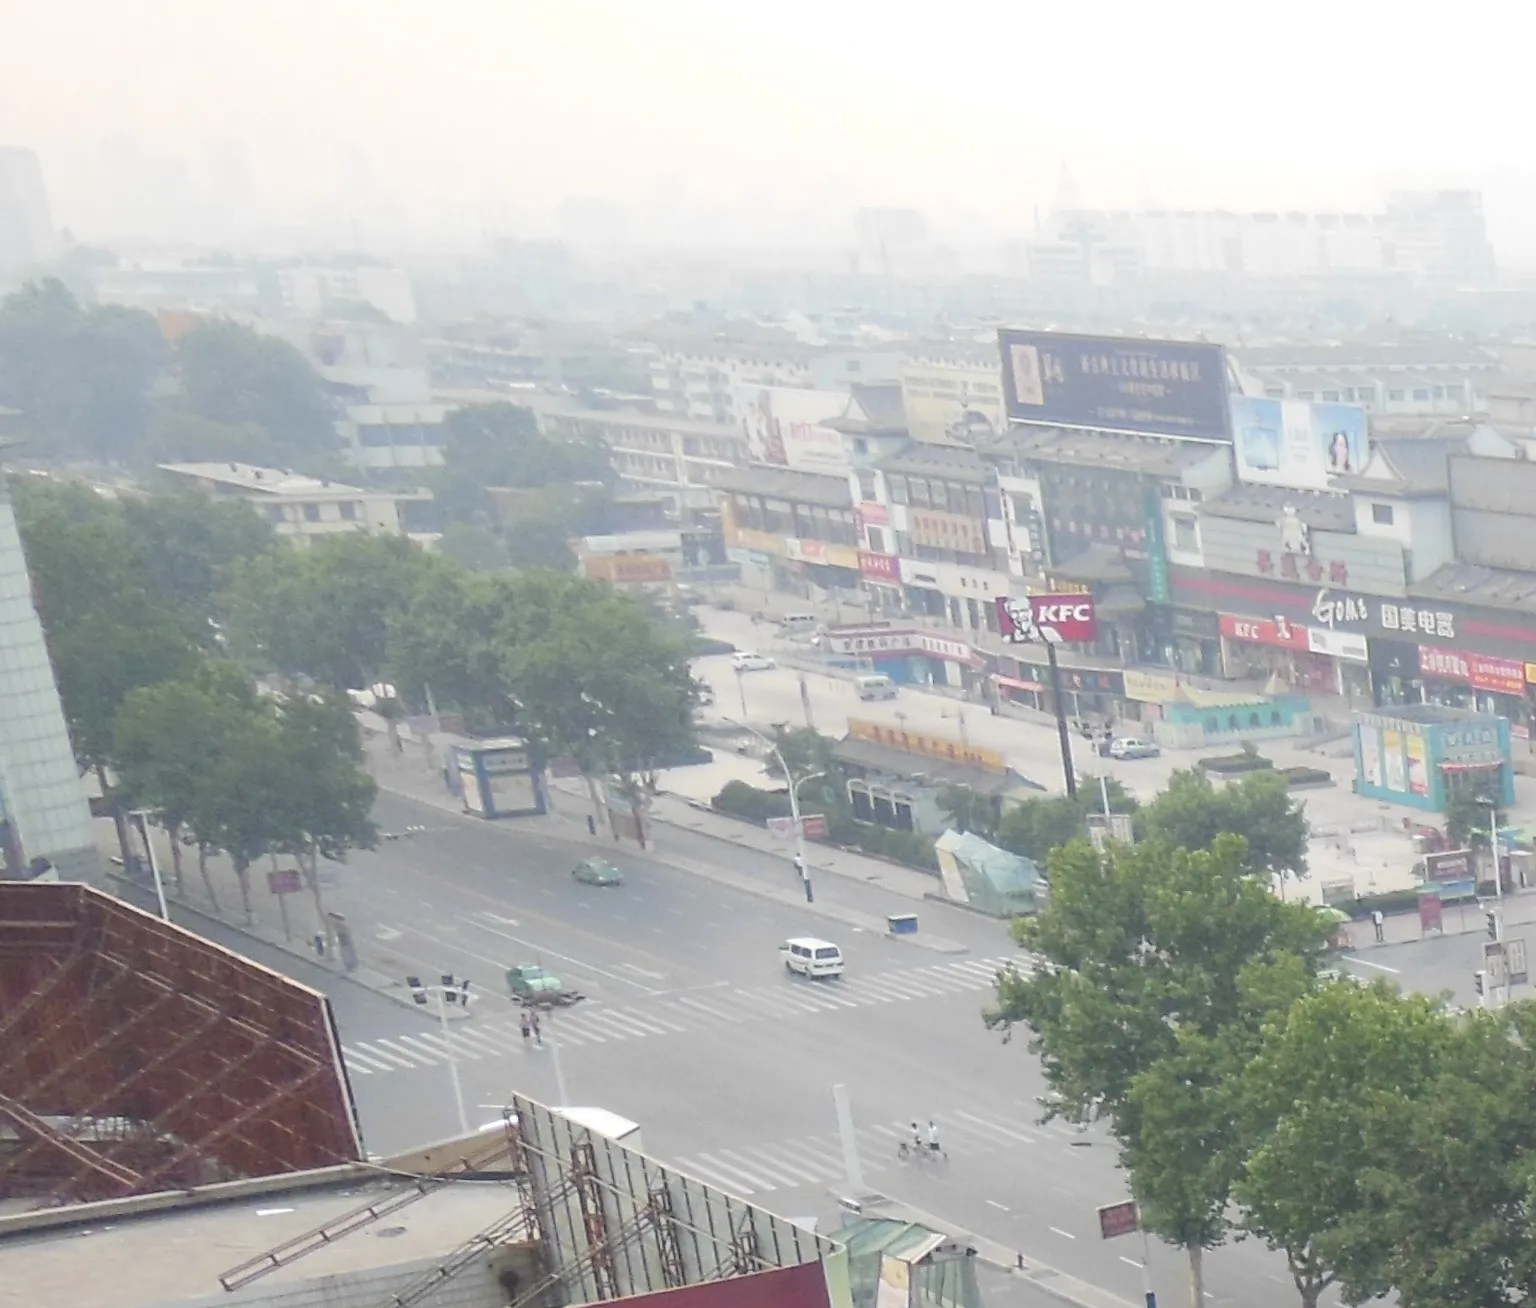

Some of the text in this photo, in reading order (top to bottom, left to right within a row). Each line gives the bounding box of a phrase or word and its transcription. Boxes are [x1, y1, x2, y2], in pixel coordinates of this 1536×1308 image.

[1039, 604, 1090, 623] KFC
[1381, 604, 1454, 638] 国美电器
[1234, 622, 1258, 639] KFC
